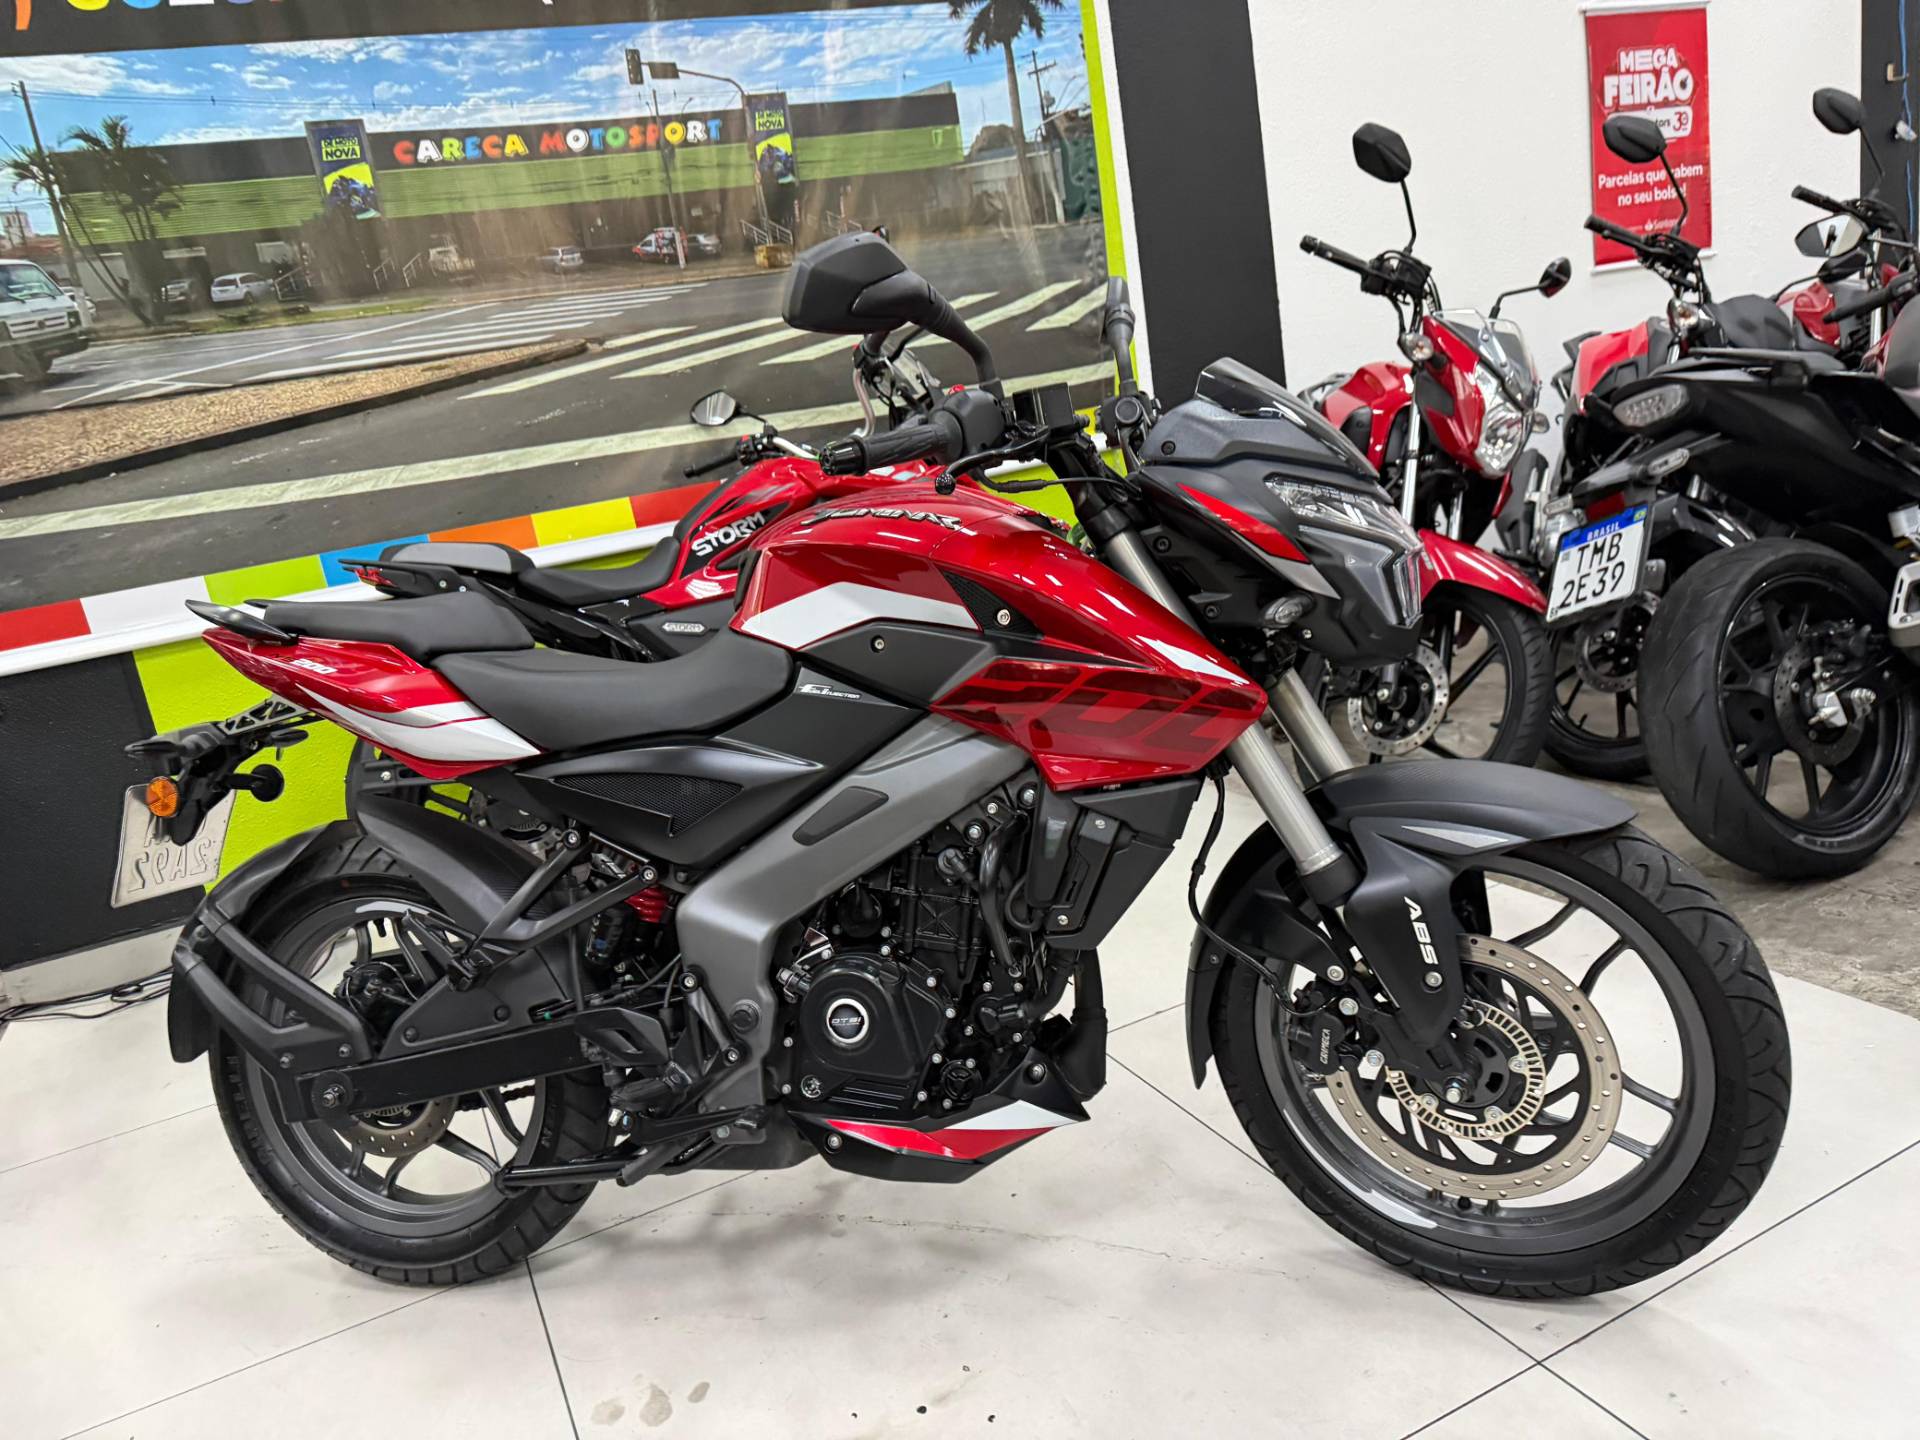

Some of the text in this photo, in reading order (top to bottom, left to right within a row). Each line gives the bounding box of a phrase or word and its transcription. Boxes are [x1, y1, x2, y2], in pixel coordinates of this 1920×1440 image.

[1620, 47, 1679, 73] MEGA
[1603, 66, 1694, 108] FEIRÃO
[325, 147, 359, 159] NOVA
[393, 119, 722, 165] CARECA MOTOSPORT
[1598, 170, 1644, 189] Parcelas
[1646, 170, 1667, 186] que
[1617, 194, 1632, 207] no
[1634, 190, 1653, 205] seu
[691, 511, 765, 557] STORM
[1587, 521, 1621, 543] BRASIL
[1578, 533, 1623, 574] TMB
[1558, 561, 1625, 609] 2E39
[1403, 896, 1439, 965] ABS
